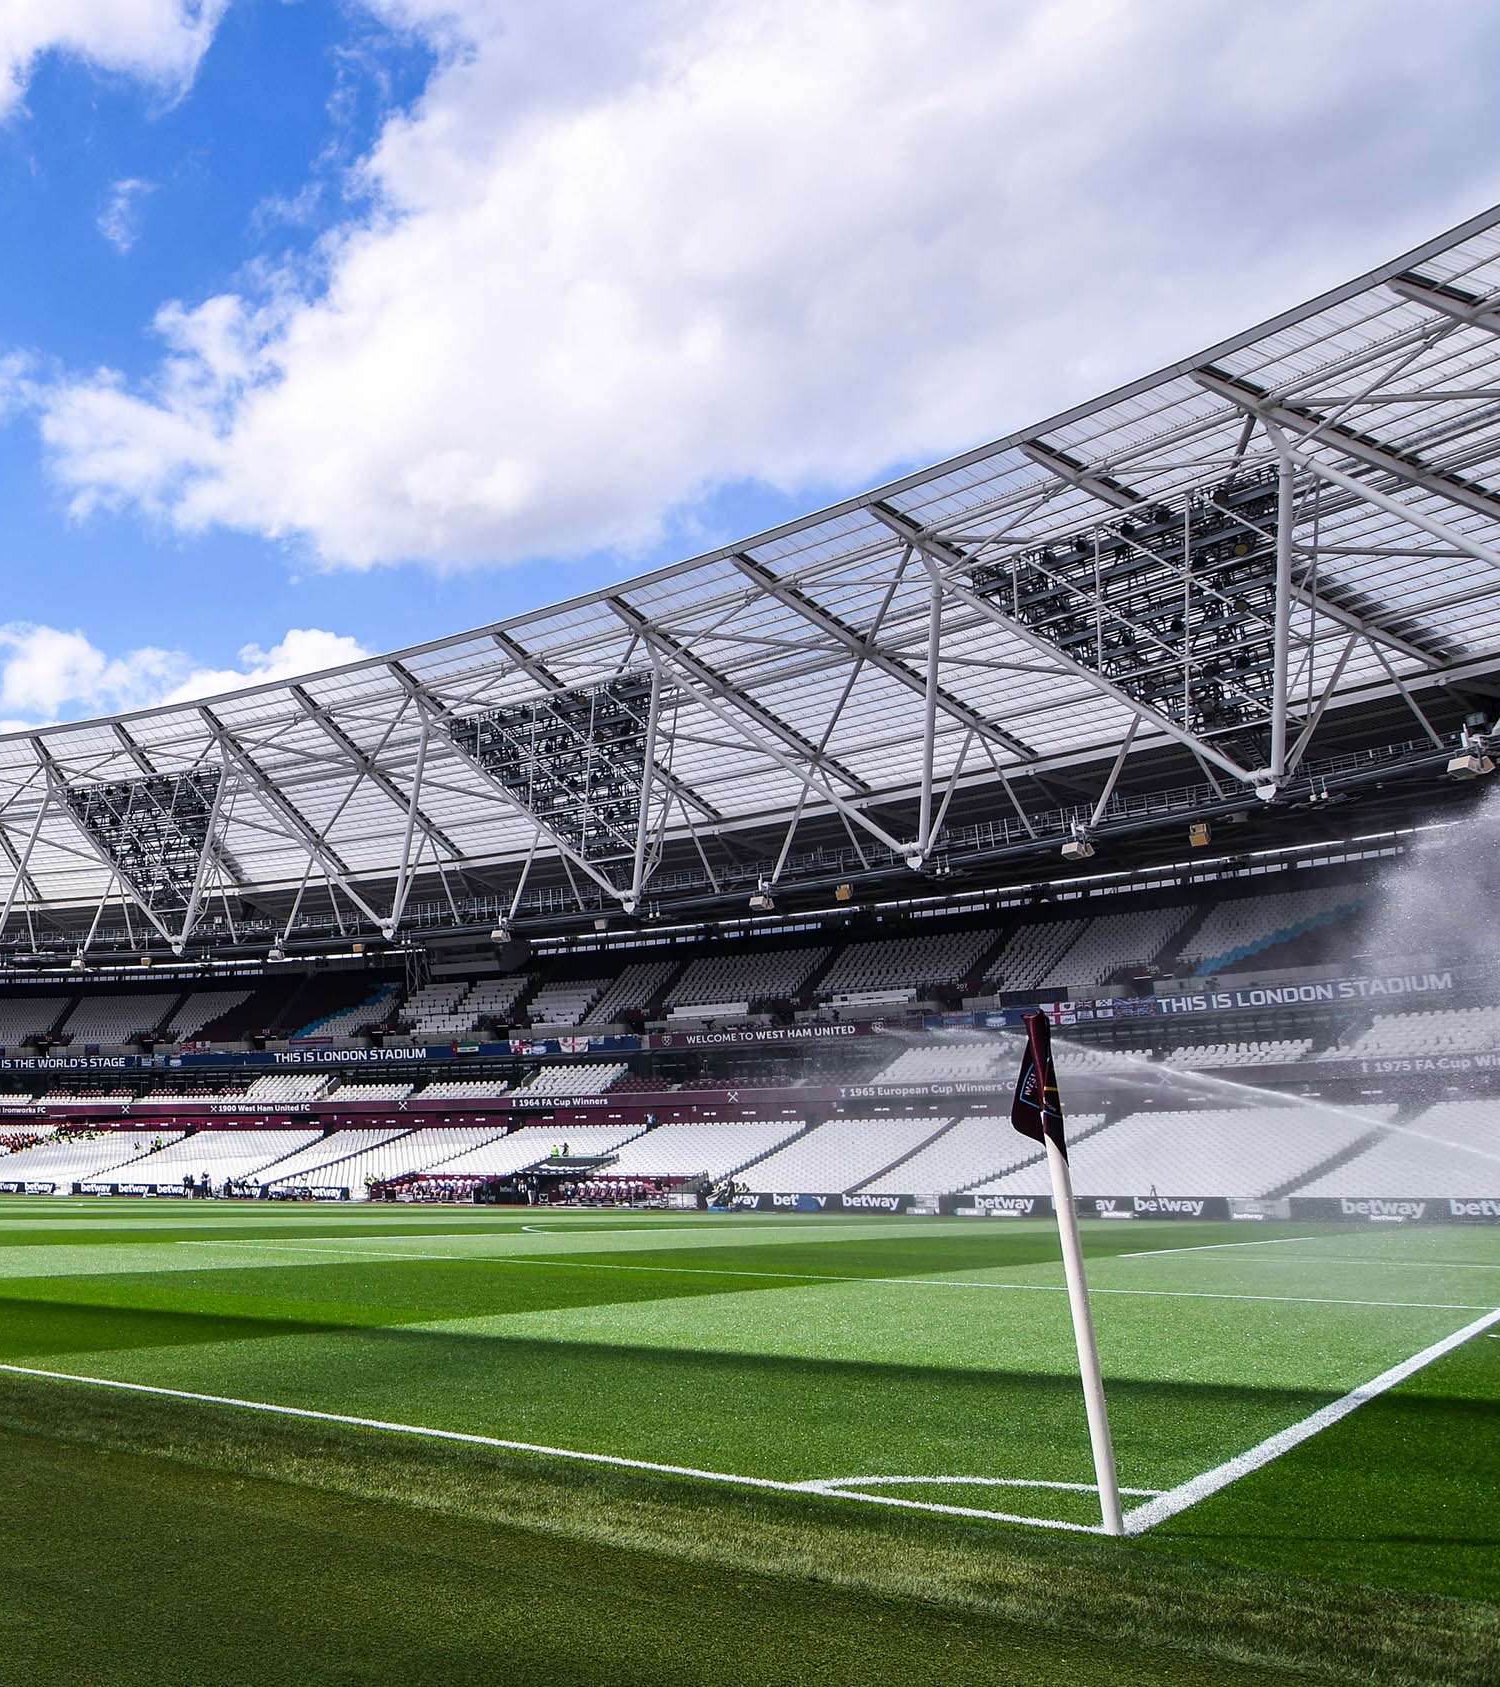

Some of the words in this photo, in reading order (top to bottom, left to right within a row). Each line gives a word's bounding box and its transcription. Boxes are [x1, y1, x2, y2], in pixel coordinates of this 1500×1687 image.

[1157, 996, 1206, 1013] THIS
[1212, 993, 1231, 1009] IS
[1236, 986, 1333, 1007] LONDON
[1339, 973, 1452, 998] STADIUM
[686, 1034, 737, 1044] WELCOME
[739, 1032, 753, 1041] TO
[756, 1030, 785, 1040] WEST
[788, 1028, 812, 1038] HAM
[814, 1025, 856, 1036] UNITED
[274, 1053, 301, 1063] THIS
[303, 1052, 314, 1062] IS
[317, 1050, 367, 1062] LONDON
[370, 1048, 426, 1060] STADIUM
[2, 1059, 11, 1069] IS
[13, 1059, 35, 1068] THE
[37, 1058, 88, 1068] WORLD'S
[90, 1057, 125, 1067] STAGE
[1374, 1061, 1412, 1072] 1975
[1415, 1059, 1436, 1070] FA
[1440, 1058, 1470, 1071] Cup
[850, 1087, 875, 1097] 1965
[877, 1085, 928, 1098] European
[931, 1084, 953, 1096] Cup
[256, 1104, 273, 1112] Ham
[519, 1099, 540, 1107] 1964
[542, 1098, 552, 1106] FA
[553, 1098, 571, 1107] Cup
[572, 1097, 608, 1106] Winners
[81, 1183, 111, 1193] betway
[118, 1184, 149, 1194] betway
[842, 1194, 900, 1210] betway
[974, 1195, 1034, 1213] betway
[1133, 1197, 1204, 1216] betway
[1341, 1199, 1427, 1219] betway
